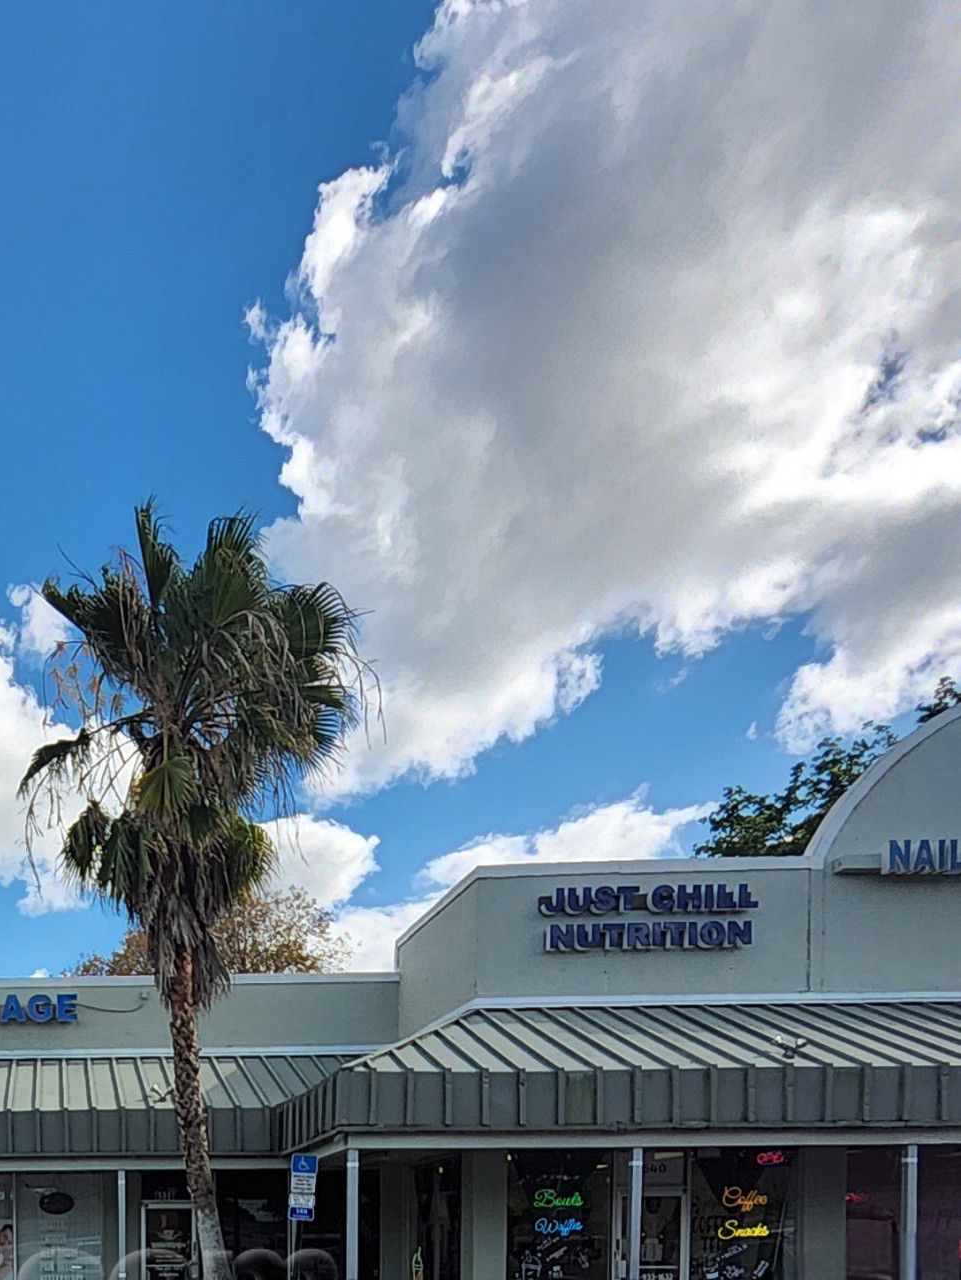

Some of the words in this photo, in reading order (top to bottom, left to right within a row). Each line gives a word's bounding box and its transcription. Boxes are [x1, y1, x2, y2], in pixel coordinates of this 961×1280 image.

[540, 885, 641, 915] JUST
[648, 884, 759, 913] CHILL
[546, 920, 753, 950] NUTRITION
[534, 1189, 584, 1207] Bowls
[722, 1186, 768, 1211] Coffee
[718, 1219, 769, 1240] Snacks
